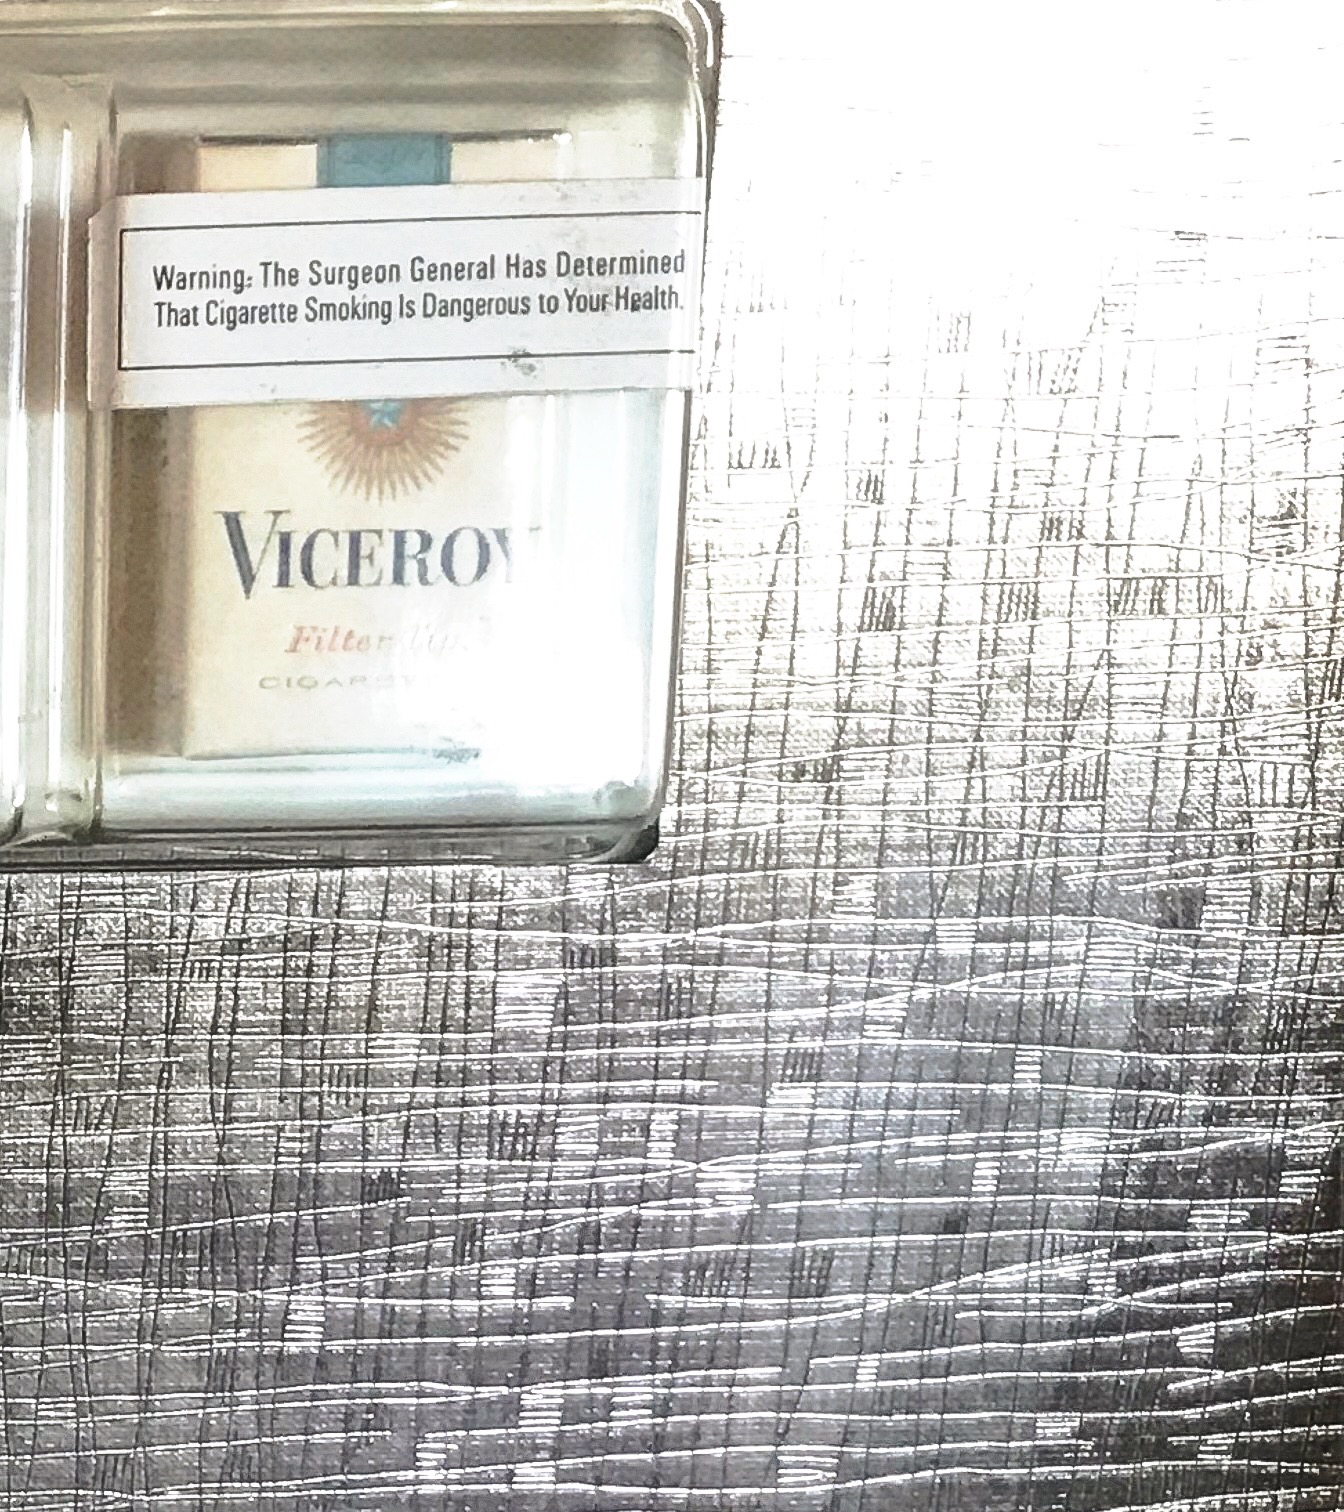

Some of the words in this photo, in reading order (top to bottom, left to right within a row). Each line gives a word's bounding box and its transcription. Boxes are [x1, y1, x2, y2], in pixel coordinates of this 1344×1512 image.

[153, 263, 253, 294] Warning:
[260, 261, 300, 288] The
[309, 257, 401, 291] Surgeon
[410, 254, 495, 283] General
[505, 253, 547, 280] Has
[556, 248, 686, 278] Determined
[154, 302, 199, 329] That
[205, 300, 298, 332] Cigarette
[305, 296, 393, 326] Smoking
[399, 295, 416, 319] Is
[422, 293, 531, 323] Dangerous
[538, 293, 560, 314] to
[564, 289, 610, 314] Your
[614, 286, 685, 314] Health.
[283, 624, 394, 655] Filter
